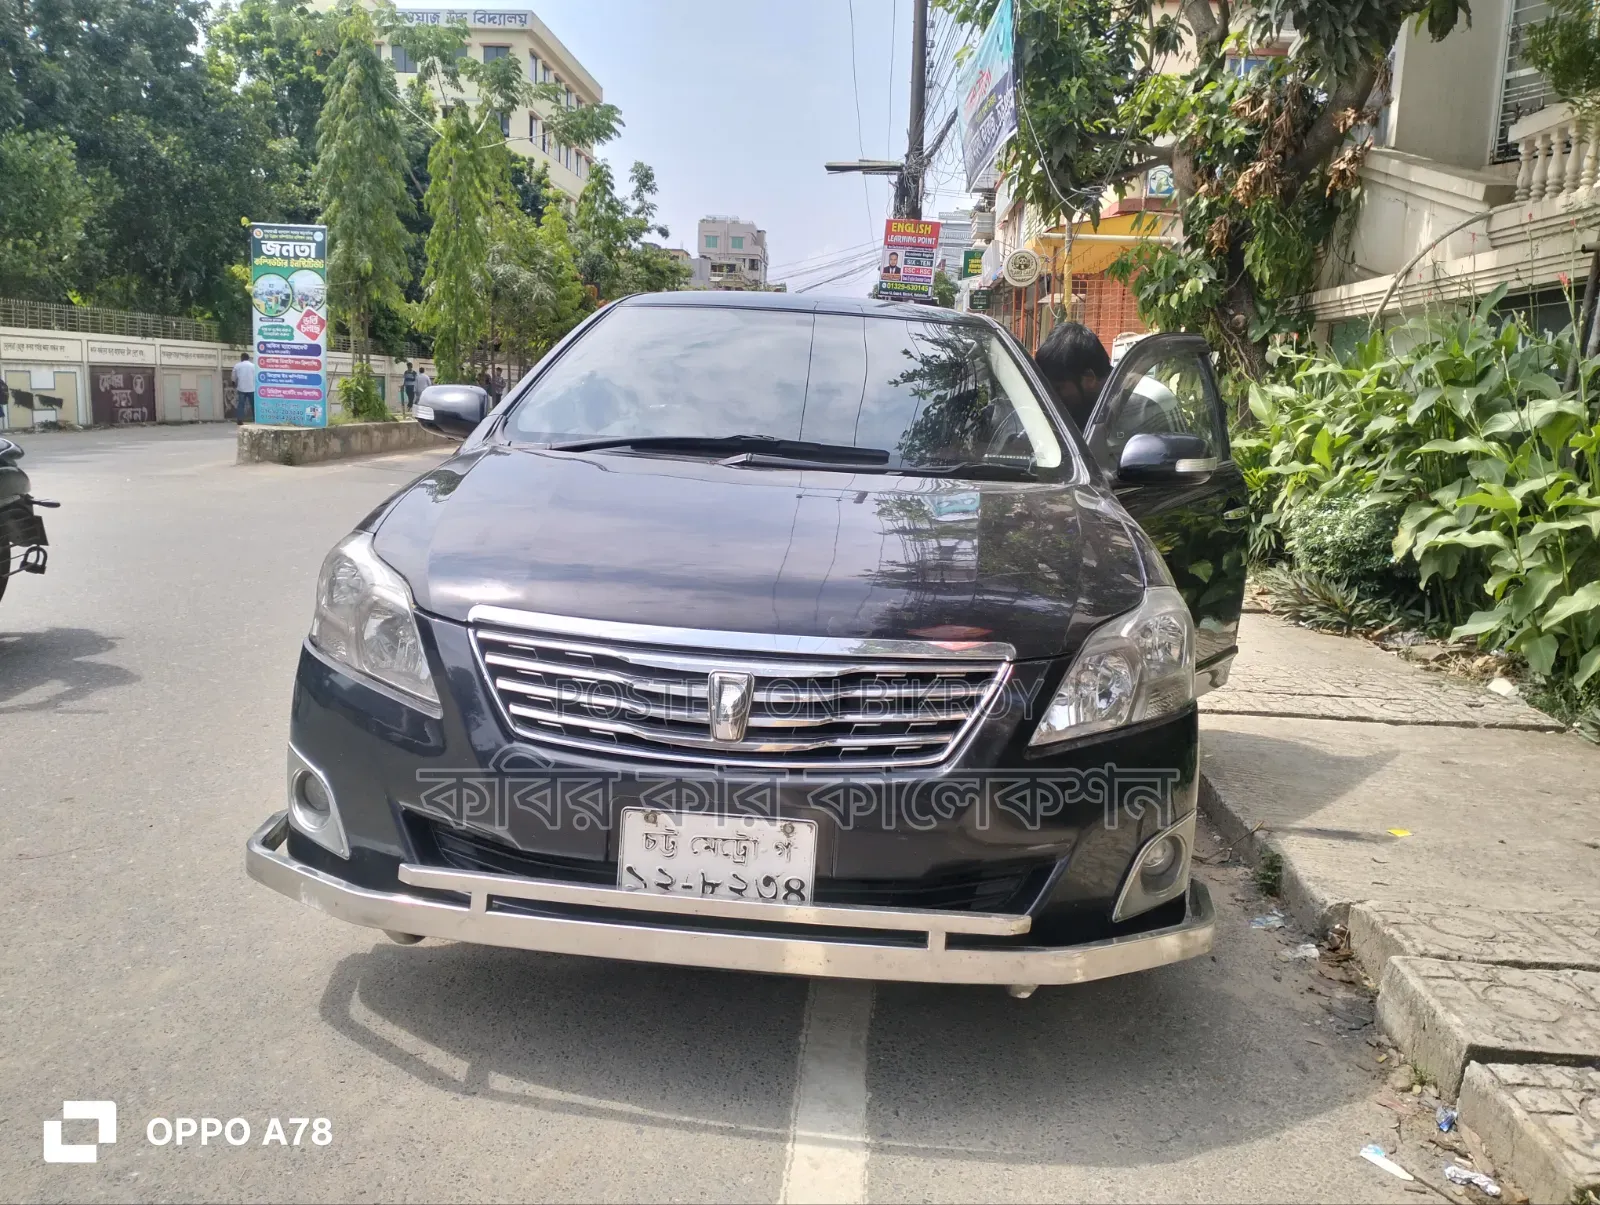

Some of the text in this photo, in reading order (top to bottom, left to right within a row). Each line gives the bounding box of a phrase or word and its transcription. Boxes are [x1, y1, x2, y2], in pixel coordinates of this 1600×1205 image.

[473, 9, 528, 27] বিদ্যালয়
[891, 222, 932, 234] ENGLISH
[887, 235, 936, 245] LEARNING POINT
[261, 241, 316, 257] জনতা
[303, 315, 318, 325] ভর্তি
[300, 324, 320, 334] চলছে
